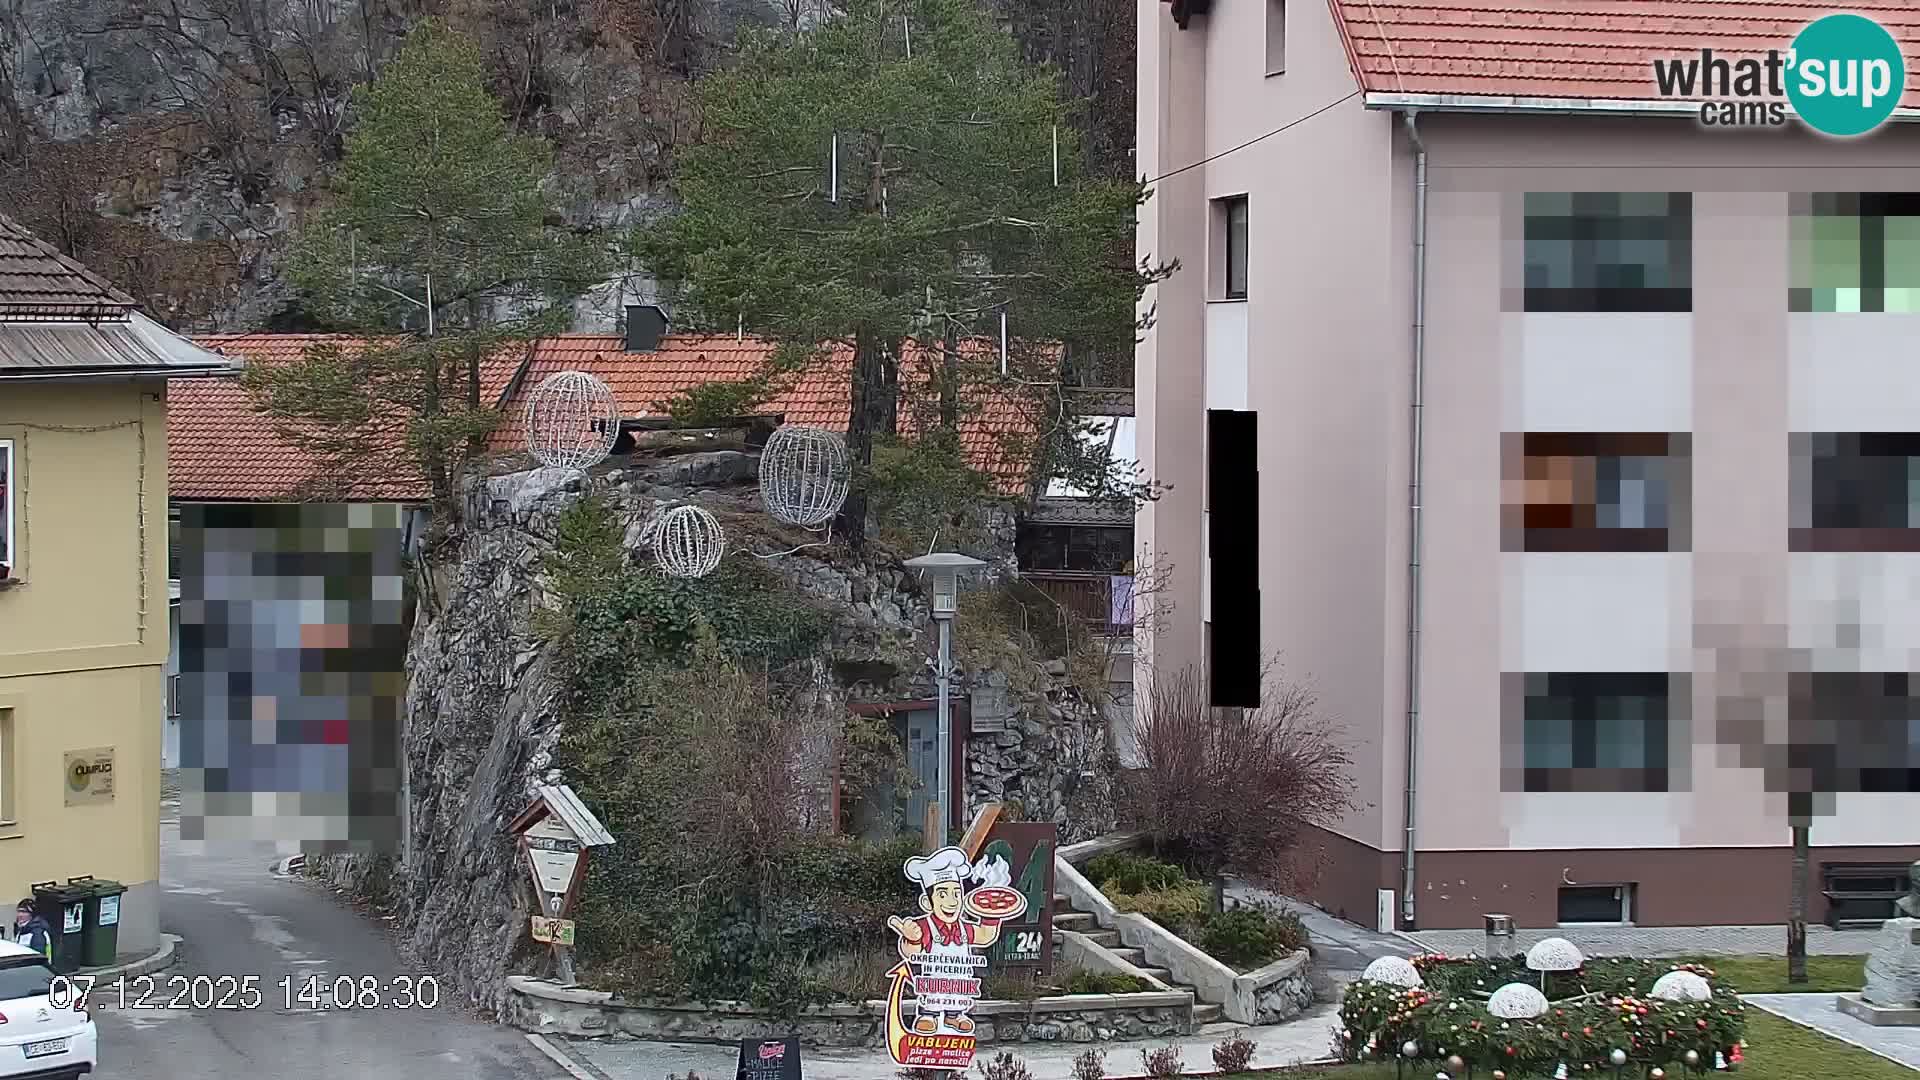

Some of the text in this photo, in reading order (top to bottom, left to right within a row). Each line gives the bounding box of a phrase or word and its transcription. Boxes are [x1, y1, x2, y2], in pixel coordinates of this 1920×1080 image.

[910, 953, 986, 966] OKREPČEVALNICA
[923, 964, 972, 975] IN PICERIJA
[916, 977, 980, 995] KURNIK
[907, 1036, 975, 1049] VABLJENI
[910, 1047, 971, 1057] pizze malice
[906, 1054, 923, 1064] jedi
[925, 1057, 936, 1065] po
